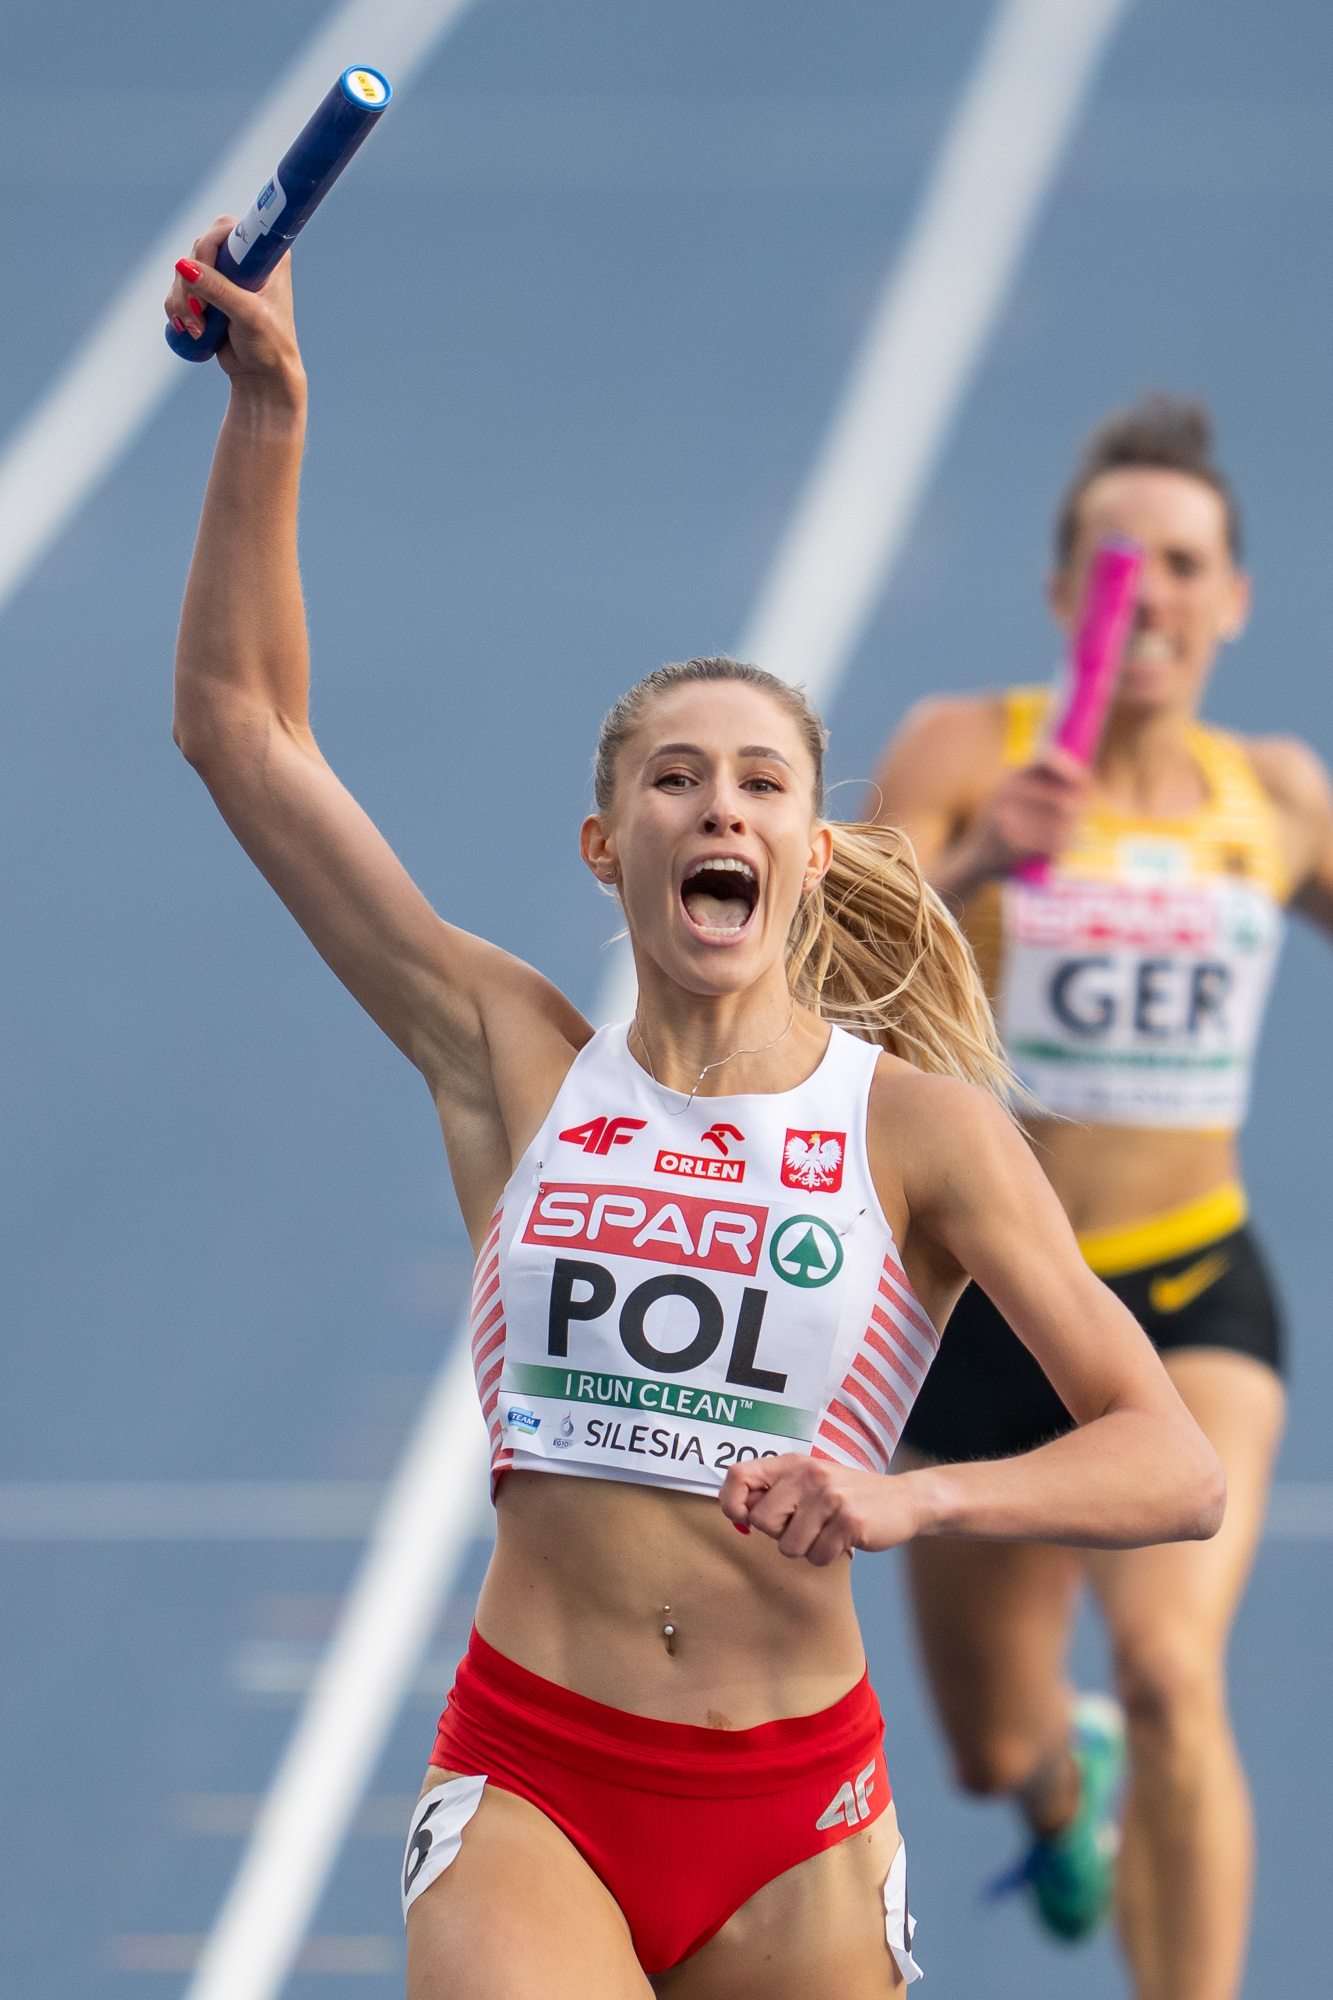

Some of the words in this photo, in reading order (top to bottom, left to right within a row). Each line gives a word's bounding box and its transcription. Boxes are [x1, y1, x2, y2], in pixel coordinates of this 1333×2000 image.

[1047, 956, 1233, 1038] GER
[558, 1116, 648, 1156] 4F
[659, 1155, 740, 1180] ORLEN
[533, 1191, 758, 1265] SPAR
[547, 1257, 788, 1394] POL
[511, 1413, 536, 1427] TEAM
[565, 1373, 573, 1396] I
[577, 1374, 634, 1404] RUN
[583, 1418, 706, 1466] SILESIA
[713, 1441, 779, 1470] 20
[815, 1757, 876, 1831] 4F
[404, 1798, 444, 1897] 6
